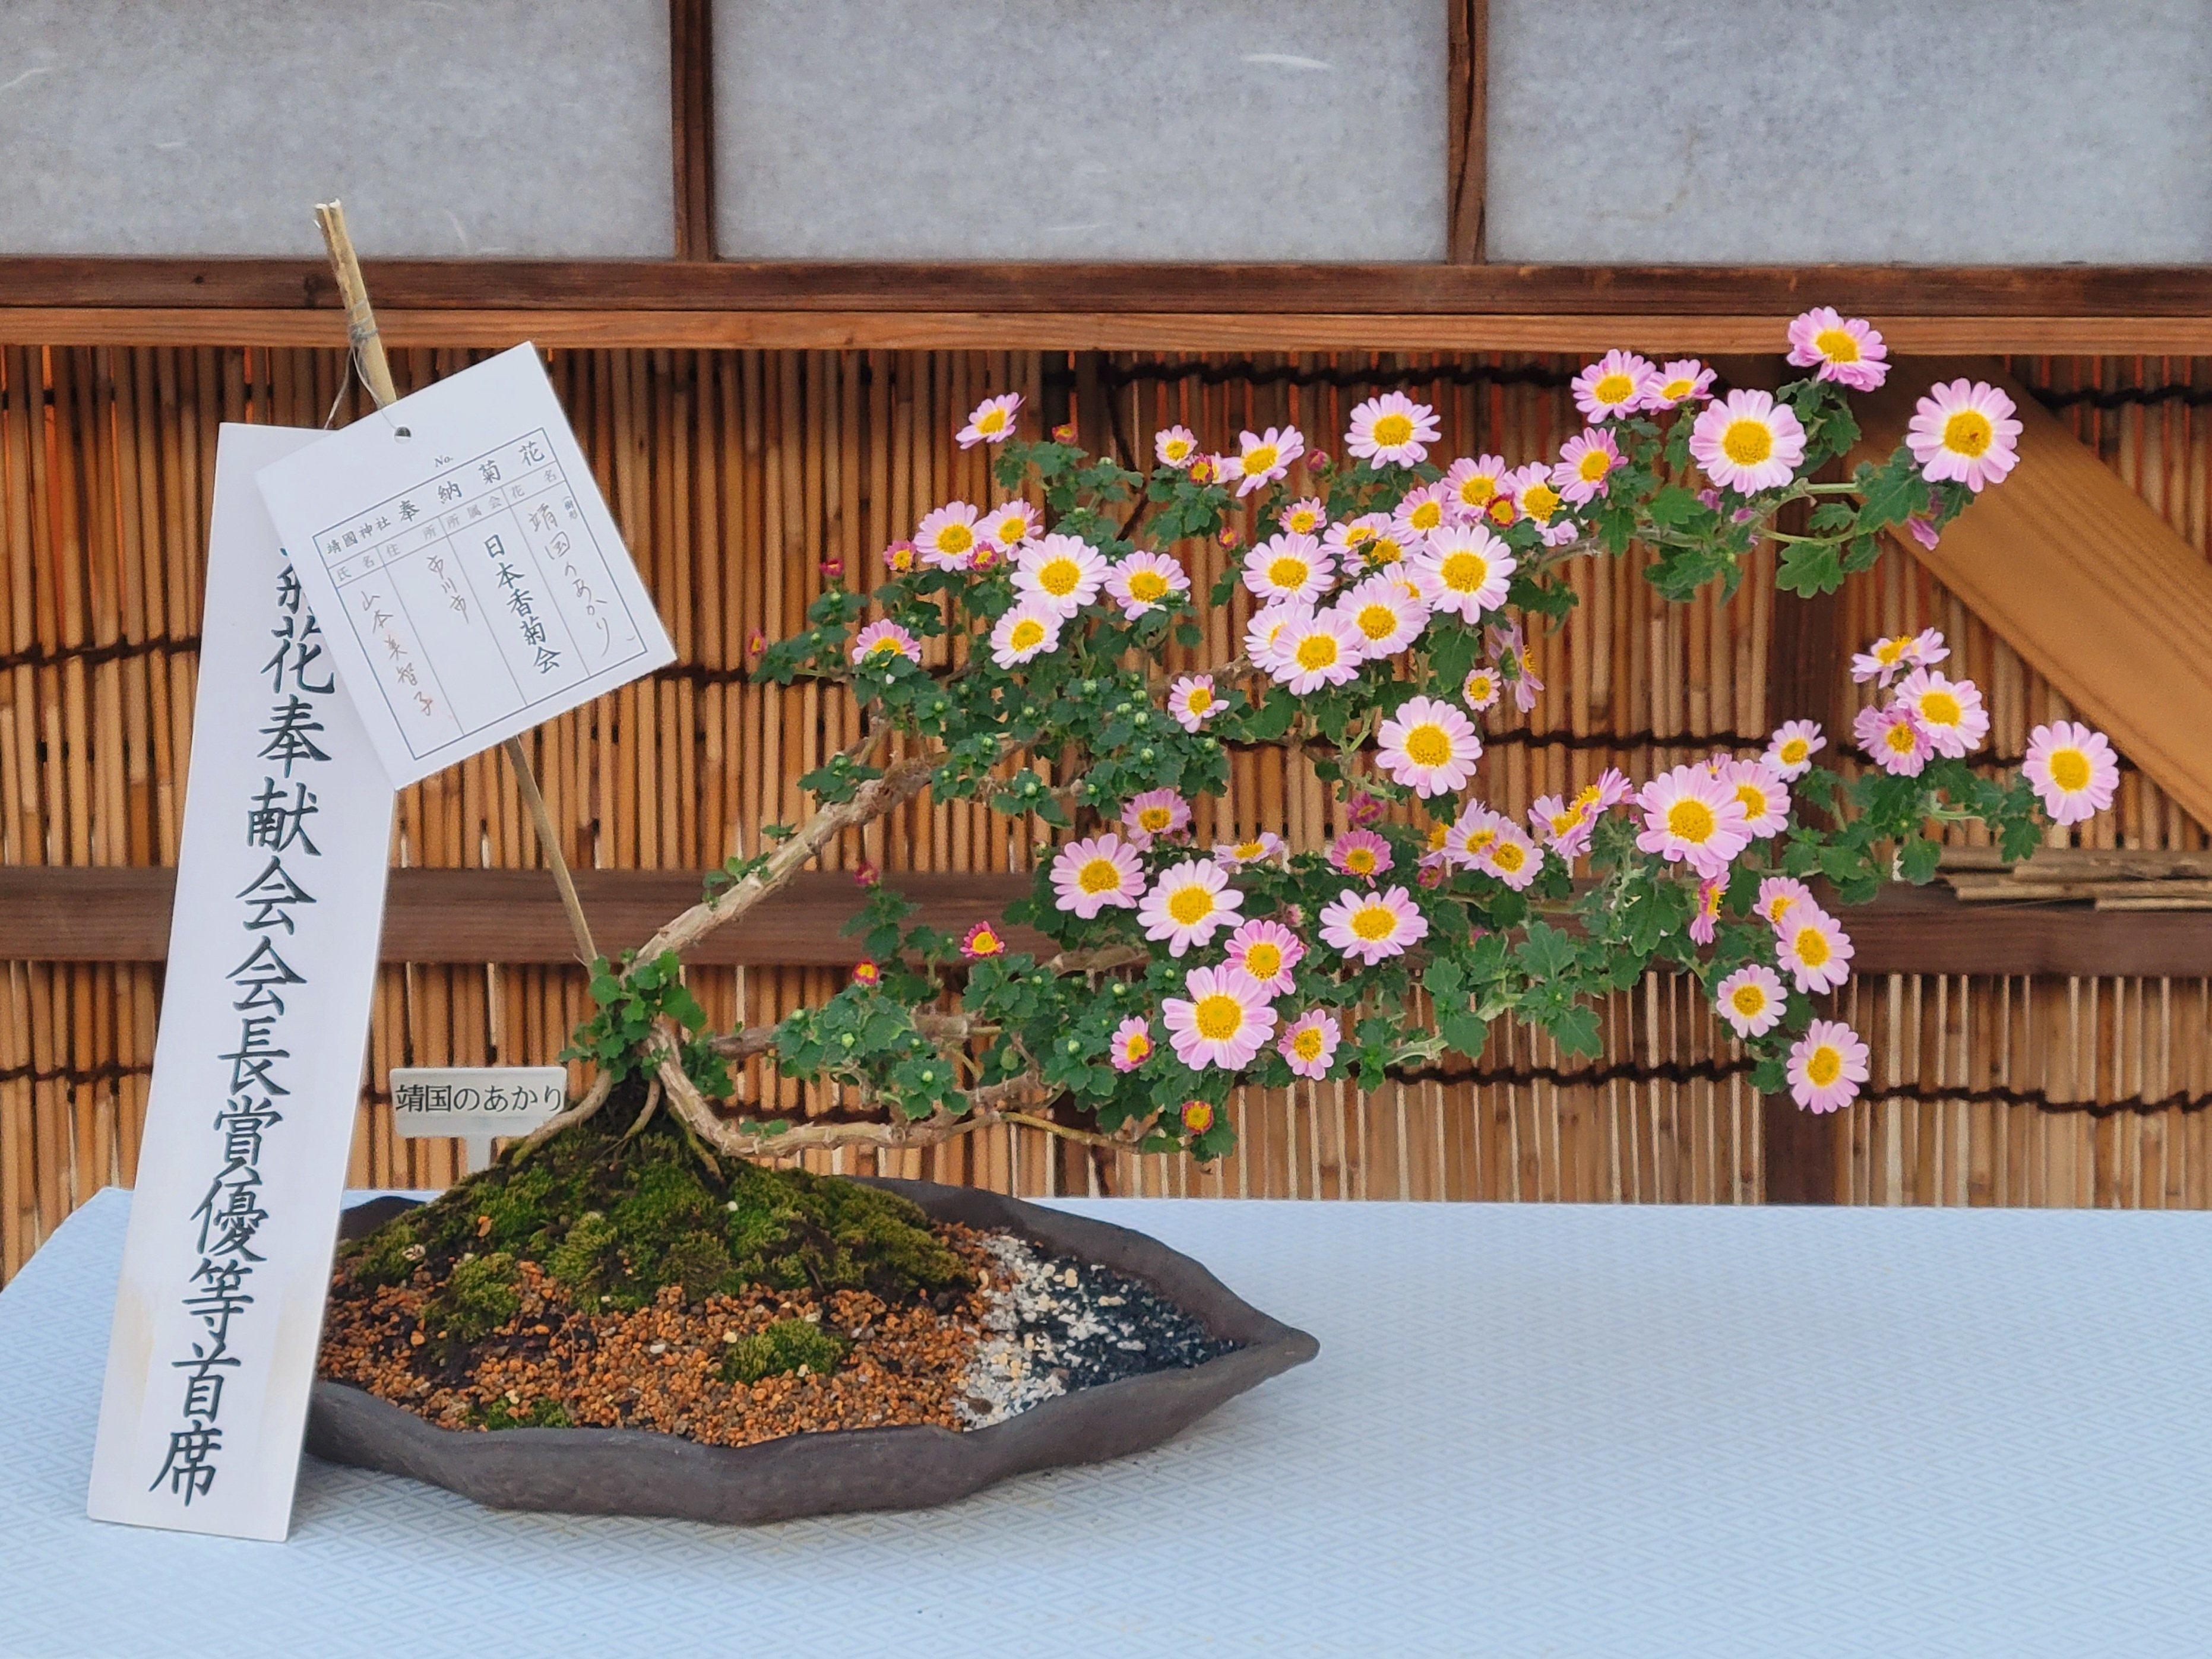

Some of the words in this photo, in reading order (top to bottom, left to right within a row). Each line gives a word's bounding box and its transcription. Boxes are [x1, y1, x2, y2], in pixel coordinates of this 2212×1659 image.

[433, 454, 454, 468] No.
[483, 534, 562, 674] 日本香菊会
[394, 1084, 561, 1113] 靖国のあかり
